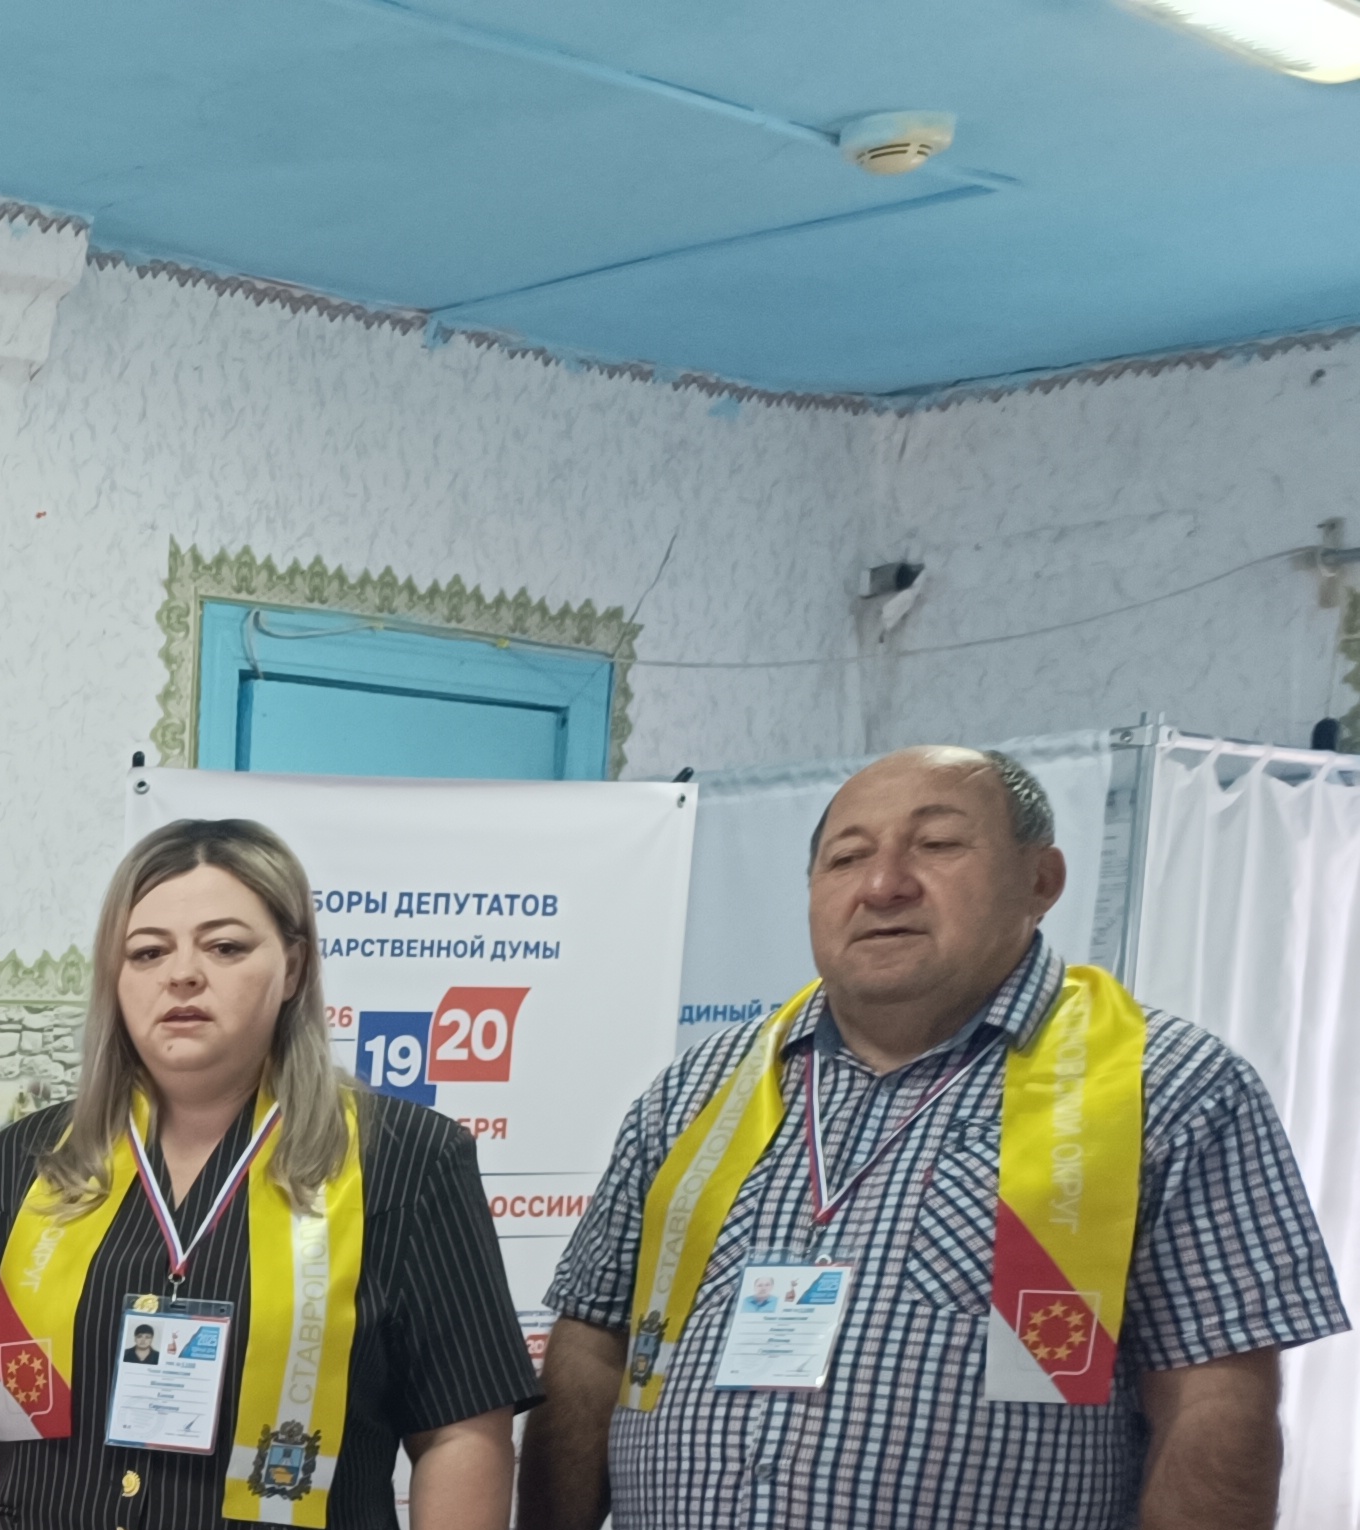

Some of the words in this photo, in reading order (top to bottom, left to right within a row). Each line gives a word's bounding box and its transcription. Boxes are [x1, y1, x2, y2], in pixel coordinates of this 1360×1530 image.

[311, 890, 387, 915] БОРЫ
[394, 891, 558, 918] ДЕПУТАТОВ
[489, 939, 560, 962] ДУМЫ
[326, 1006, 353, 1028] 26
[679, 999, 762, 1025] ДИНЫЙ
[435, 1008, 509, 1062] 20
[364, 1035, 422, 1087] 19
